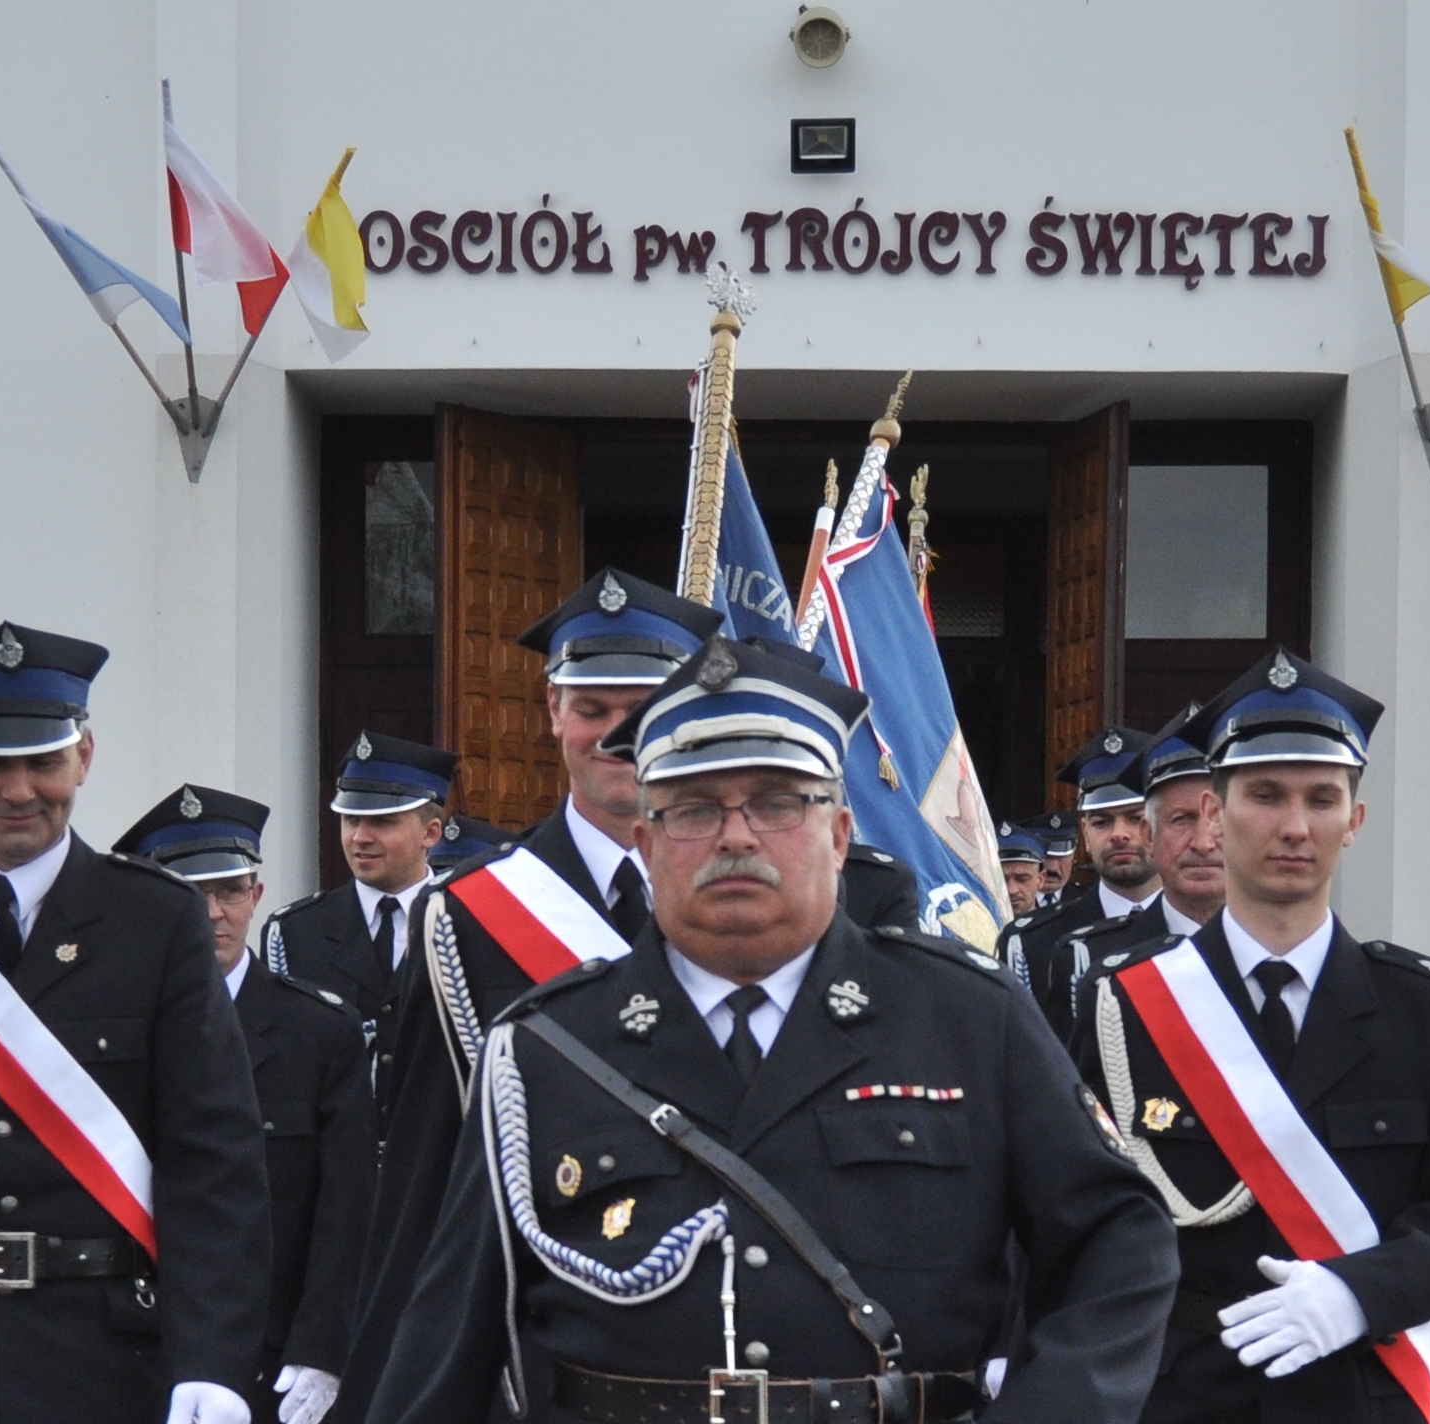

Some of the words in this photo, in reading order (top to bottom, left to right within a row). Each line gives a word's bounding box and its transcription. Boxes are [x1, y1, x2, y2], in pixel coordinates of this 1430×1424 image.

[358, 193, 613, 275] OSCIÓŁ
[740, 197, 1007, 275] TRÓJCY
[1025, 195, 1331, 291] ŚWIĘTEJ
[723, 563, 792, 634] ICZA
